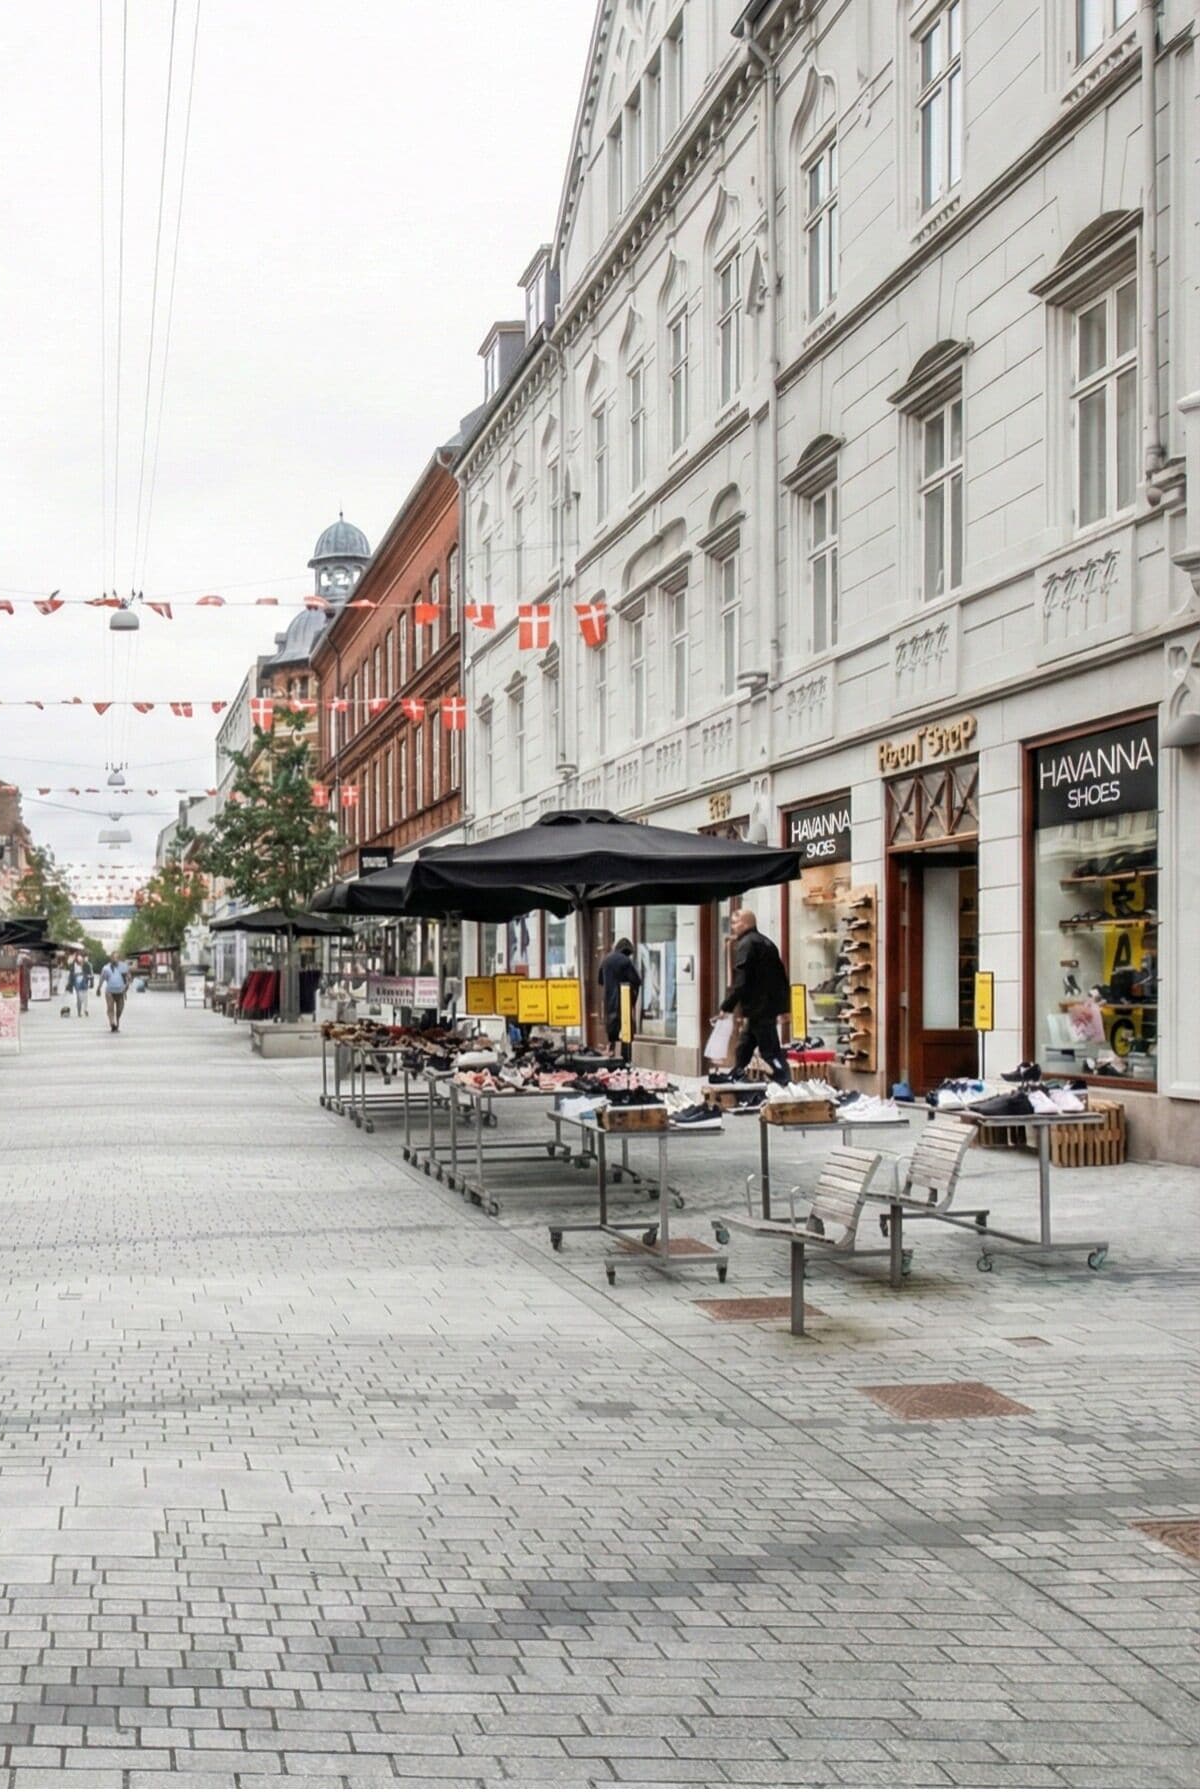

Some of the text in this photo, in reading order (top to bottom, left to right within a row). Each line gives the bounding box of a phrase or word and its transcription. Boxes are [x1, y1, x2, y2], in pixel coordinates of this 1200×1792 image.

[1039, 737, 1154, 791] HAVANNA
[1067, 781, 1121, 809] SHOES
[791, 809, 852, 843] HAVANNA
